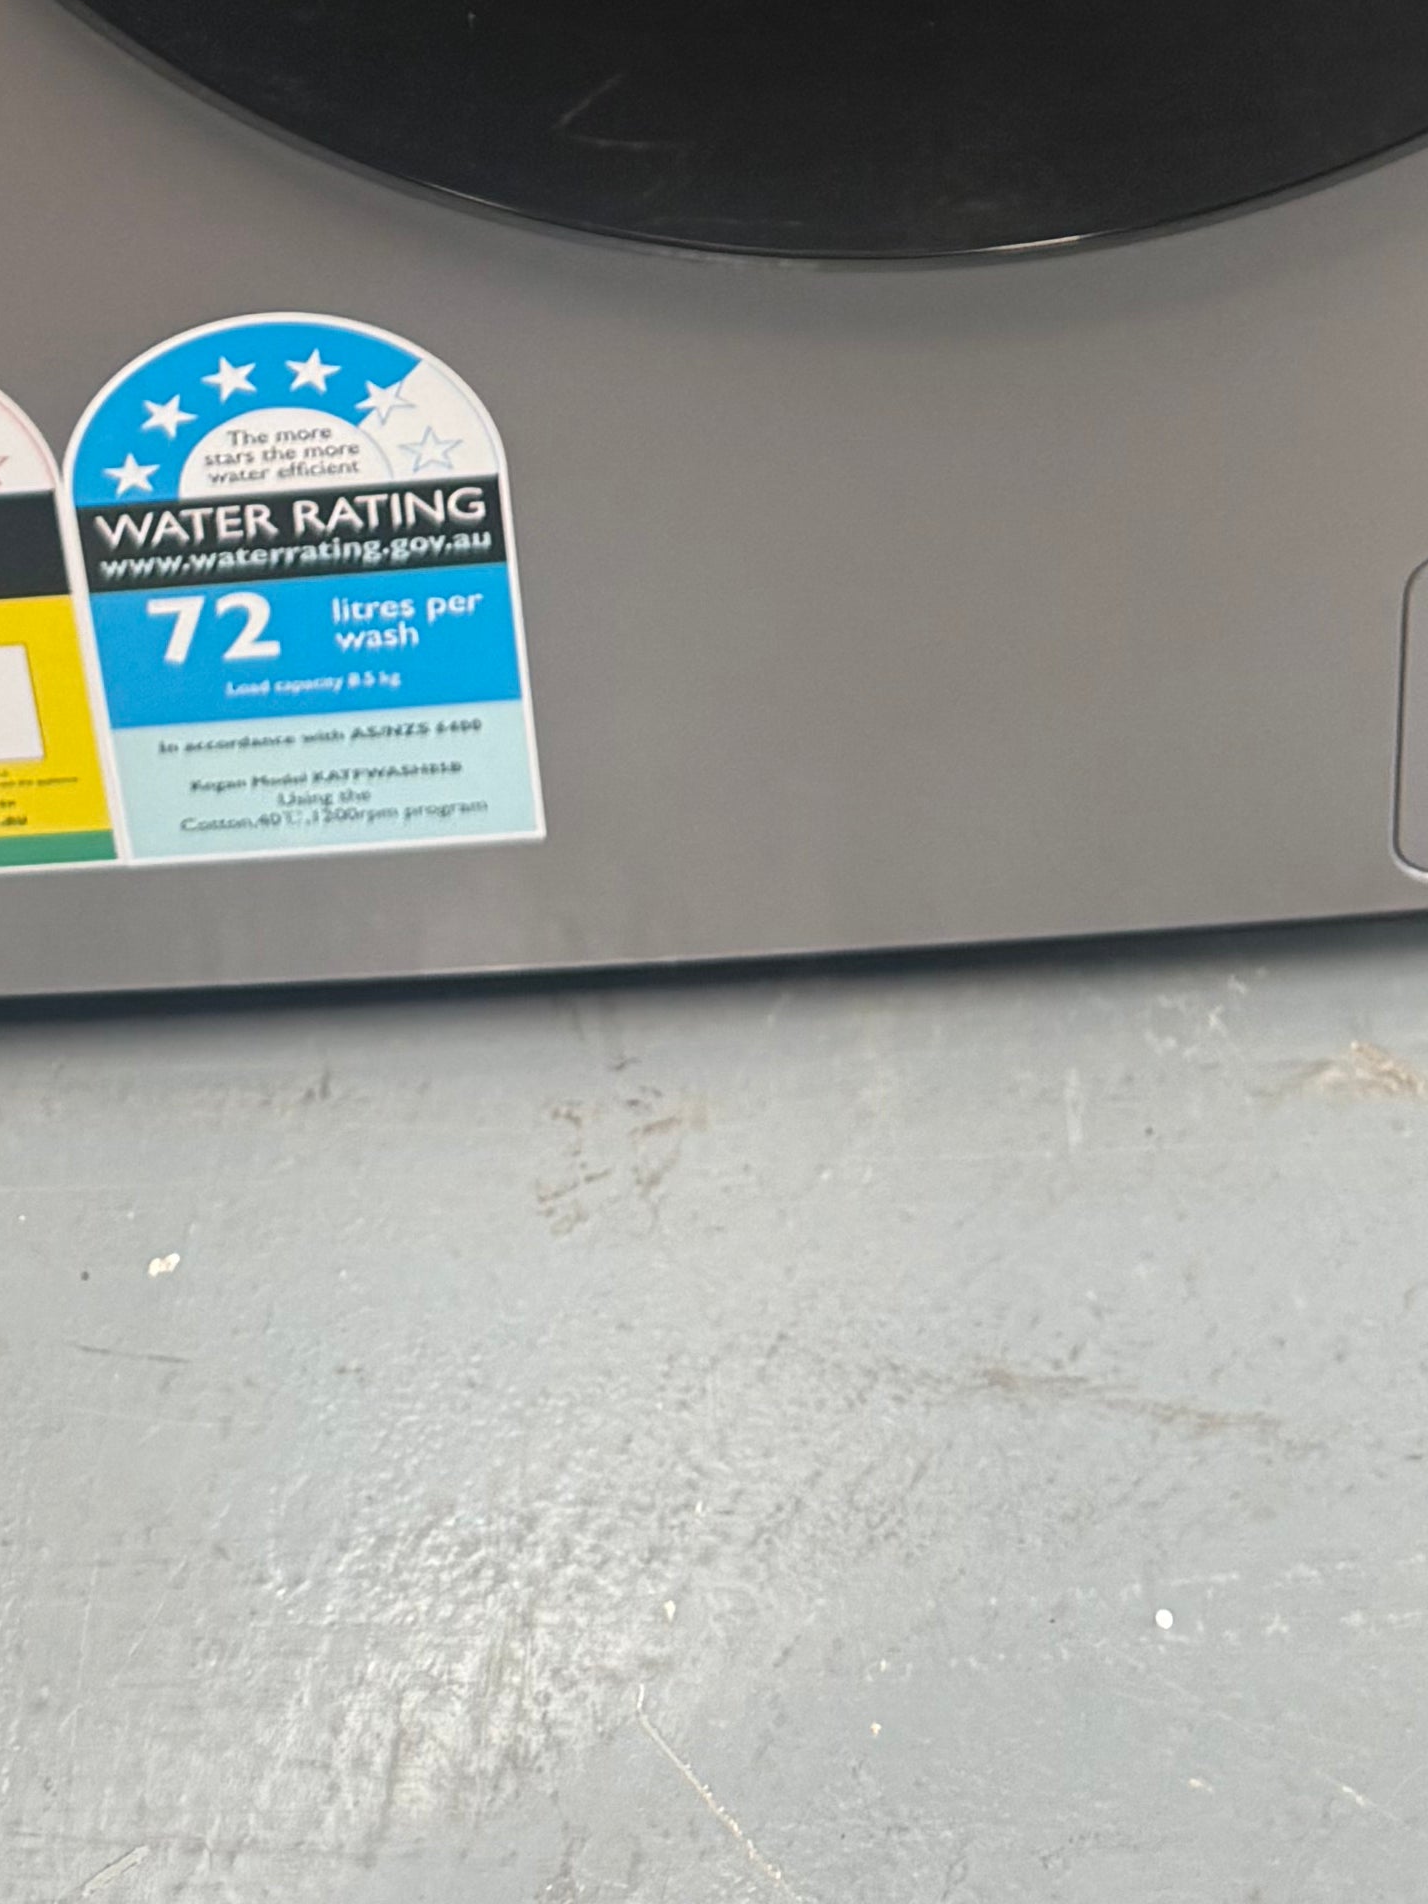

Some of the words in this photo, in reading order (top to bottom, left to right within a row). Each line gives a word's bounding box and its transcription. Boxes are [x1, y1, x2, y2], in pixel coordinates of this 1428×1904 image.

[227, 430, 269, 446] The
[276, 427, 332, 442] more
[204, 450, 254, 466] stars
[262, 446, 297, 461] the
[304, 443, 360, 458] more
[208, 468, 270, 483] water
[277, 461, 359, 479] efficient
[94, 503, 278, 550] WATER
[293, 487, 485, 537] RATING
[100, 530, 493, 581] www.waterrating.gov.au
[146, 592, 281, 665] 72
[332, 596, 417, 625] litres
[427, 593, 483, 624] per
[335, 622, 420, 652] wash
[225, 680, 270, 696] Load
[274, 676, 343, 694] capacity
[379, 669, 401, 688] kg
